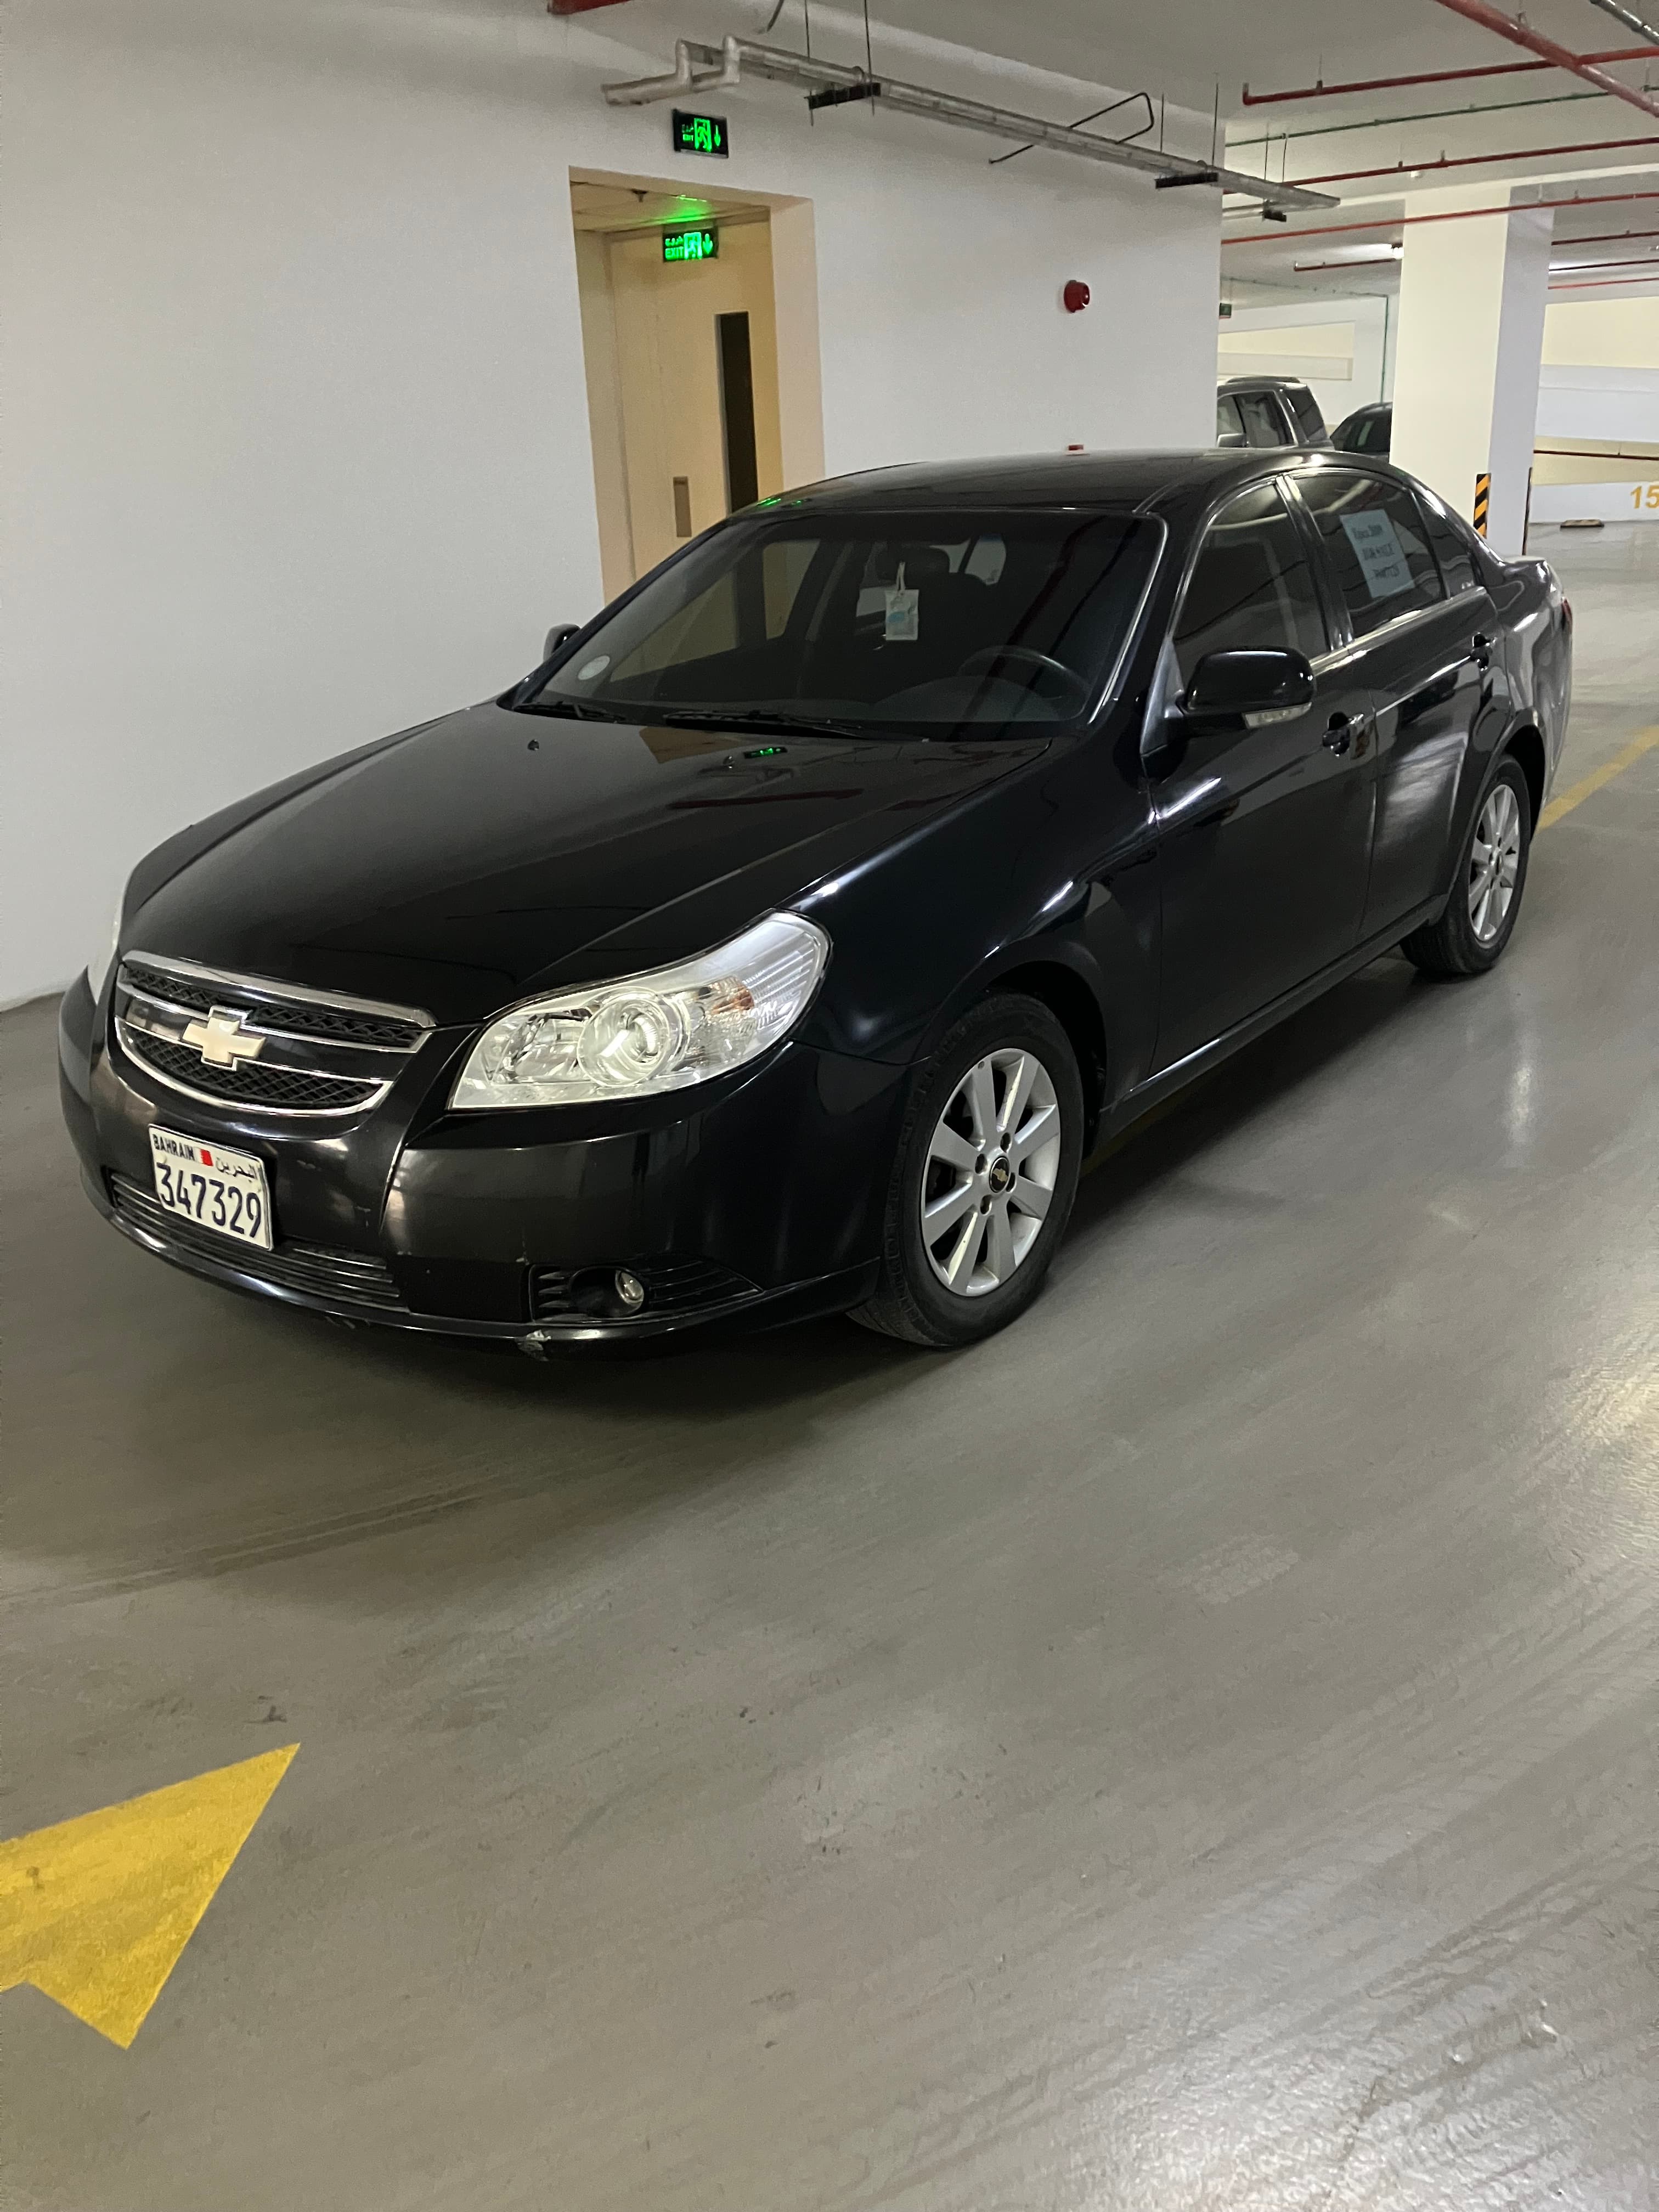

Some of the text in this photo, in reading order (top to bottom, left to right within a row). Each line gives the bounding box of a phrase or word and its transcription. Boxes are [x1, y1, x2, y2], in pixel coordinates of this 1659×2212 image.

[665, 246, 684, 259] EXIT
[153, 1133, 195, 1161] BAHRAIN
[215, 1157, 258, 1183] البحرين
[156, 1161, 262, 1238] 347329
